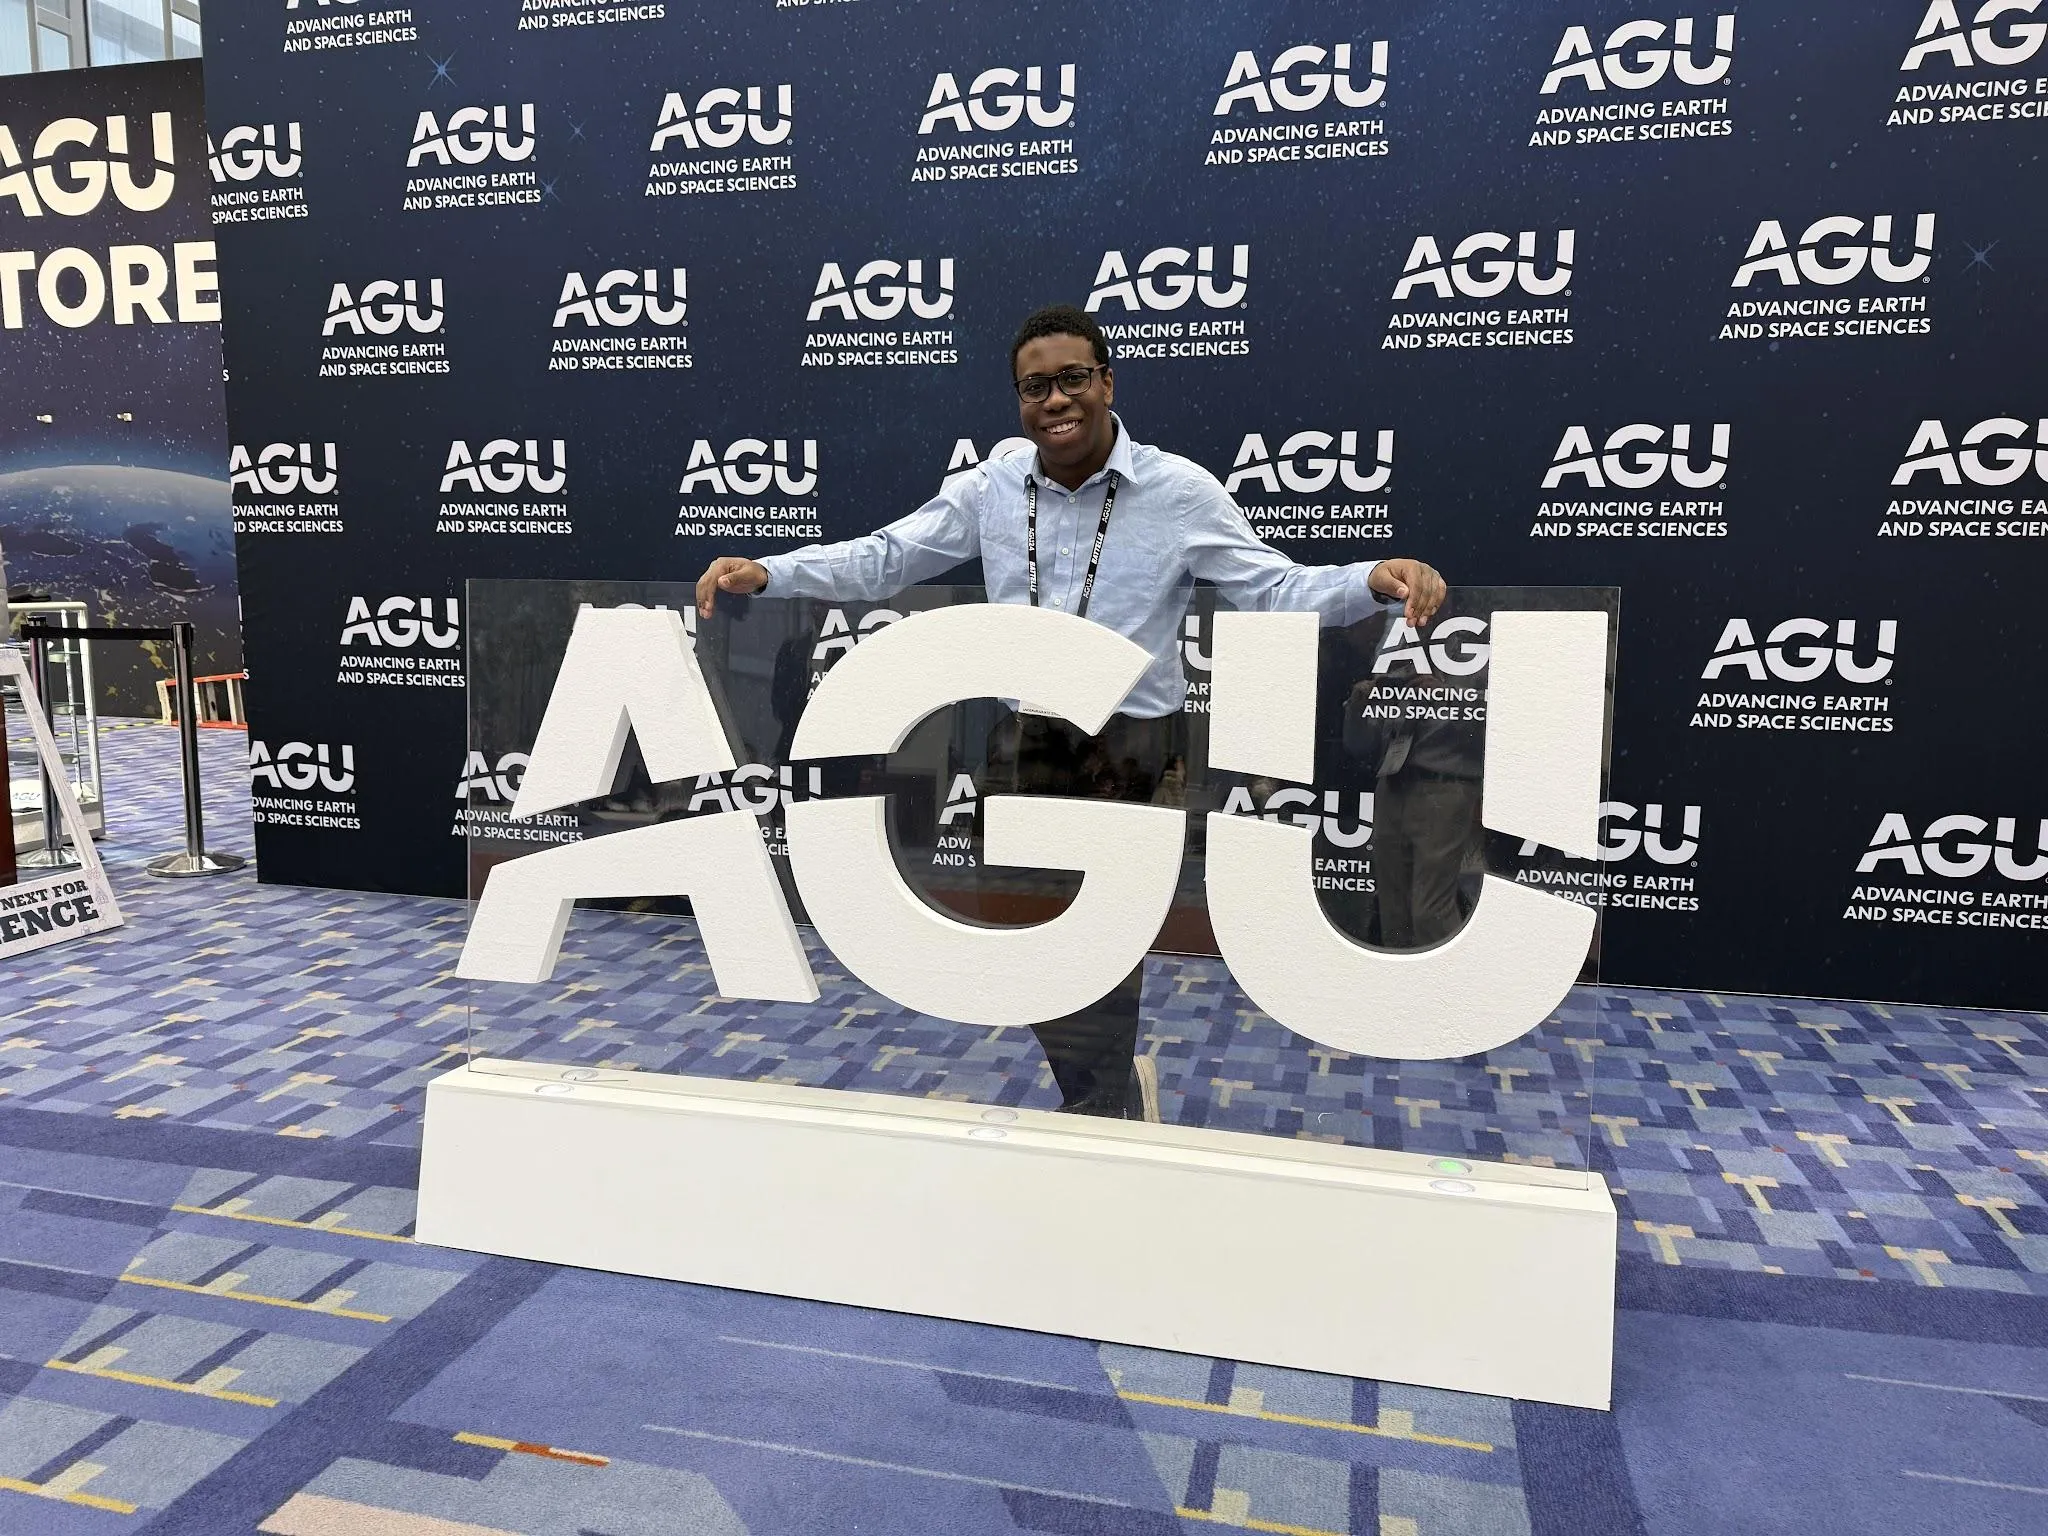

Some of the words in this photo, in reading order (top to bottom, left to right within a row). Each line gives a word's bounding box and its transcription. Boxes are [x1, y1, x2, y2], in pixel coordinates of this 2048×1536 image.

[287, 14, 364, 34] ADVANCING
[369, 9, 411, 25] EARTH
[518, 15, 548, 30] AND
[552, 11, 594, 27] SPACE
[597, 4, 665, 23] SCIENCES
[284, 38, 311, 52] AND
[314, 34, 353, 49] SPACE
[356, 27, 417, 45] SCIENCES
[1895, 79, 2027, 102] ADVANCING
[1536, 103, 1655, 124] ADVANCING
[1662, 98, 1727, 116] EARTH
[1886, 108, 1933, 125] AND
[1939, 104, 2004, 122] SPACE
[1211, 124, 1318, 144] ADVANCING
[1325, 120, 1383, 137] EARTH
[1528, 130, 1571, 146] AND
[1576, 126, 1634, 143] SPACE
[1638, 120, 1732, 140] SCIENCES
[916, 143, 1014, 162] ADVANCING
[1020, 139, 1072, 156] EARTH
[1205, 149, 1243, 165] AND
[1247, 146, 1300, 162] SPACE
[1304, 141, 1388, 159] SCIENCES
[649, 159, 738, 177] ADVANCING
[743, 156, 791, 171] EARTH
[911, 167, 946, 181] AND
[950, 162, 999, 181] SPACE
[1001, 159, 1078, 177] SCIENCES
[407, 175, 487, 192] ADVANCING
[492, 172, 535, 186] EARTH
[645, 182, 676, 196] AND
[680, 179, 724, 194] SPACE
[727, 175, 796, 191] SCIENCES
[263, 187, 303, 202] EARTH
[403, 197, 432, 210] AND
[435, 194, 475, 208] SPACE
[478, 190, 541, 206] SCIENCES
[212, 209, 248, 224] SPACE
[251, 204, 308, 220] SCIENCES
[1727, 299, 1851, 317] ADVANCING
[1858, 296, 1925, 313] EARTH
[1388, 311, 1501, 328] ADVANCING
[1508, 309, 1568, 324] EARTH
[1189, 321, 1244, 336] EARTH
[1719, 324, 1763, 339] AND
[1768, 321, 1829, 337] SPACE
[1833, 318, 1930, 335] SCIENCES
[552, 338, 636, 352] ADVANCING
[641, 337, 687, 350] EARTH
[806, 332, 897, 347] ADVANCING
[903, 331, 952, 345] EARTH
[1382, 334, 1421, 349] AND
[1426, 332, 1481, 347] SPACE
[1485, 329, 1573, 346] SCIENCES
[322, 345, 398, 359] ADVANCING
[403, 344, 444, 356] EARTH
[1116, 344, 1166, 358] SPACE
[1170, 340, 1249, 357] SCIENCES
[549, 357, 578, 370] AND
[582, 356, 623, 369] SPACE
[626, 355, 692, 368] SCIENCES
[801, 353, 833, 366] AND
[838, 352, 882, 365] SPACE
[886, 350, 957, 364] SCIENCES
[319, 364, 346, 376] AND
[350, 363, 387, 375] SPACE
[390, 361, 450, 374] SCIENCES
[299, 504, 338, 516] EARTH
[440, 504, 519, 516] ADVANCING
[523, 504, 566, 516] EARTH
[679, 506, 765, 519] ADVANCING
[770, 507, 816, 519] EARTH
[1331, 505, 1388, 518] EARTH
[1537, 502, 1653, 516] ADVANCING
[1660, 502, 1722, 516] EARTH
[1886, 500, 2014, 515] ADVANCING
[249, 521, 284, 532] SPACE
[287, 521, 343, 532] SCIENCES
[436, 521, 464, 532] AND
[468, 521, 507, 533] SPACE
[510, 521, 572, 534] SCIENCES
[675, 523, 705, 535] AND
[709, 524, 751, 536] SPACE
[755, 524, 822, 537] SCIENCES
[1257, 525, 1306, 538] SPACE
[1310, 524, 1392, 538] SCIENCES
[1530, 523, 1571, 536] AND
[1576, 523, 1633, 536] SPACE
[1637, 522, 1727, 536] SCIENCES
[1878, 522, 1923, 536] AND
[1928, 522, 1991, 536] SPACE
[341, 656, 415, 669] ADVANCING
[419, 658, 460, 670] EARTH
[337, 672, 364, 683] AND
[367, 673, 403, 684] SPACE
[406, 674, 465, 687] SCIENCES
[1369, 687, 1478, 701] ADVANCING
[1697, 694, 1816, 709] ADVANCING
[1824, 696, 1888, 711] EARTH
[1362, 705, 1401, 718] AND
[1405, 706, 1459, 720] SPACE
[1690, 713, 1732, 727] AND
[1737, 714, 1795, 729] SPACE
[1800, 716, 1893, 732] SCIENCES
[317, 801, 355, 813] EARTH
[268, 813, 302, 825] SPACE
[305, 815, 360, 829] SCIENCES
[537, 814, 579, 828] EARTH
[457, 603, 1608, 1059] AGU
[484, 826, 521, 840] SPACE
[1315, 858, 1370, 873] EARTH
[1515, 870, 1627, 888] ADVANCING
[1634, 876, 1693, 891] EARTH
[2, 888, 49, 911] NEXT
[51, 880, 89, 898] FOR
[1612, 894, 1698, 911] SCIENCES
[1851, 886, 1974, 905] ADVANCING
[1982, 893, 2048, 909] EARTH
[1843, 906, 1887, 920] AND
[1892, 908, 1953, 924] SPACE
